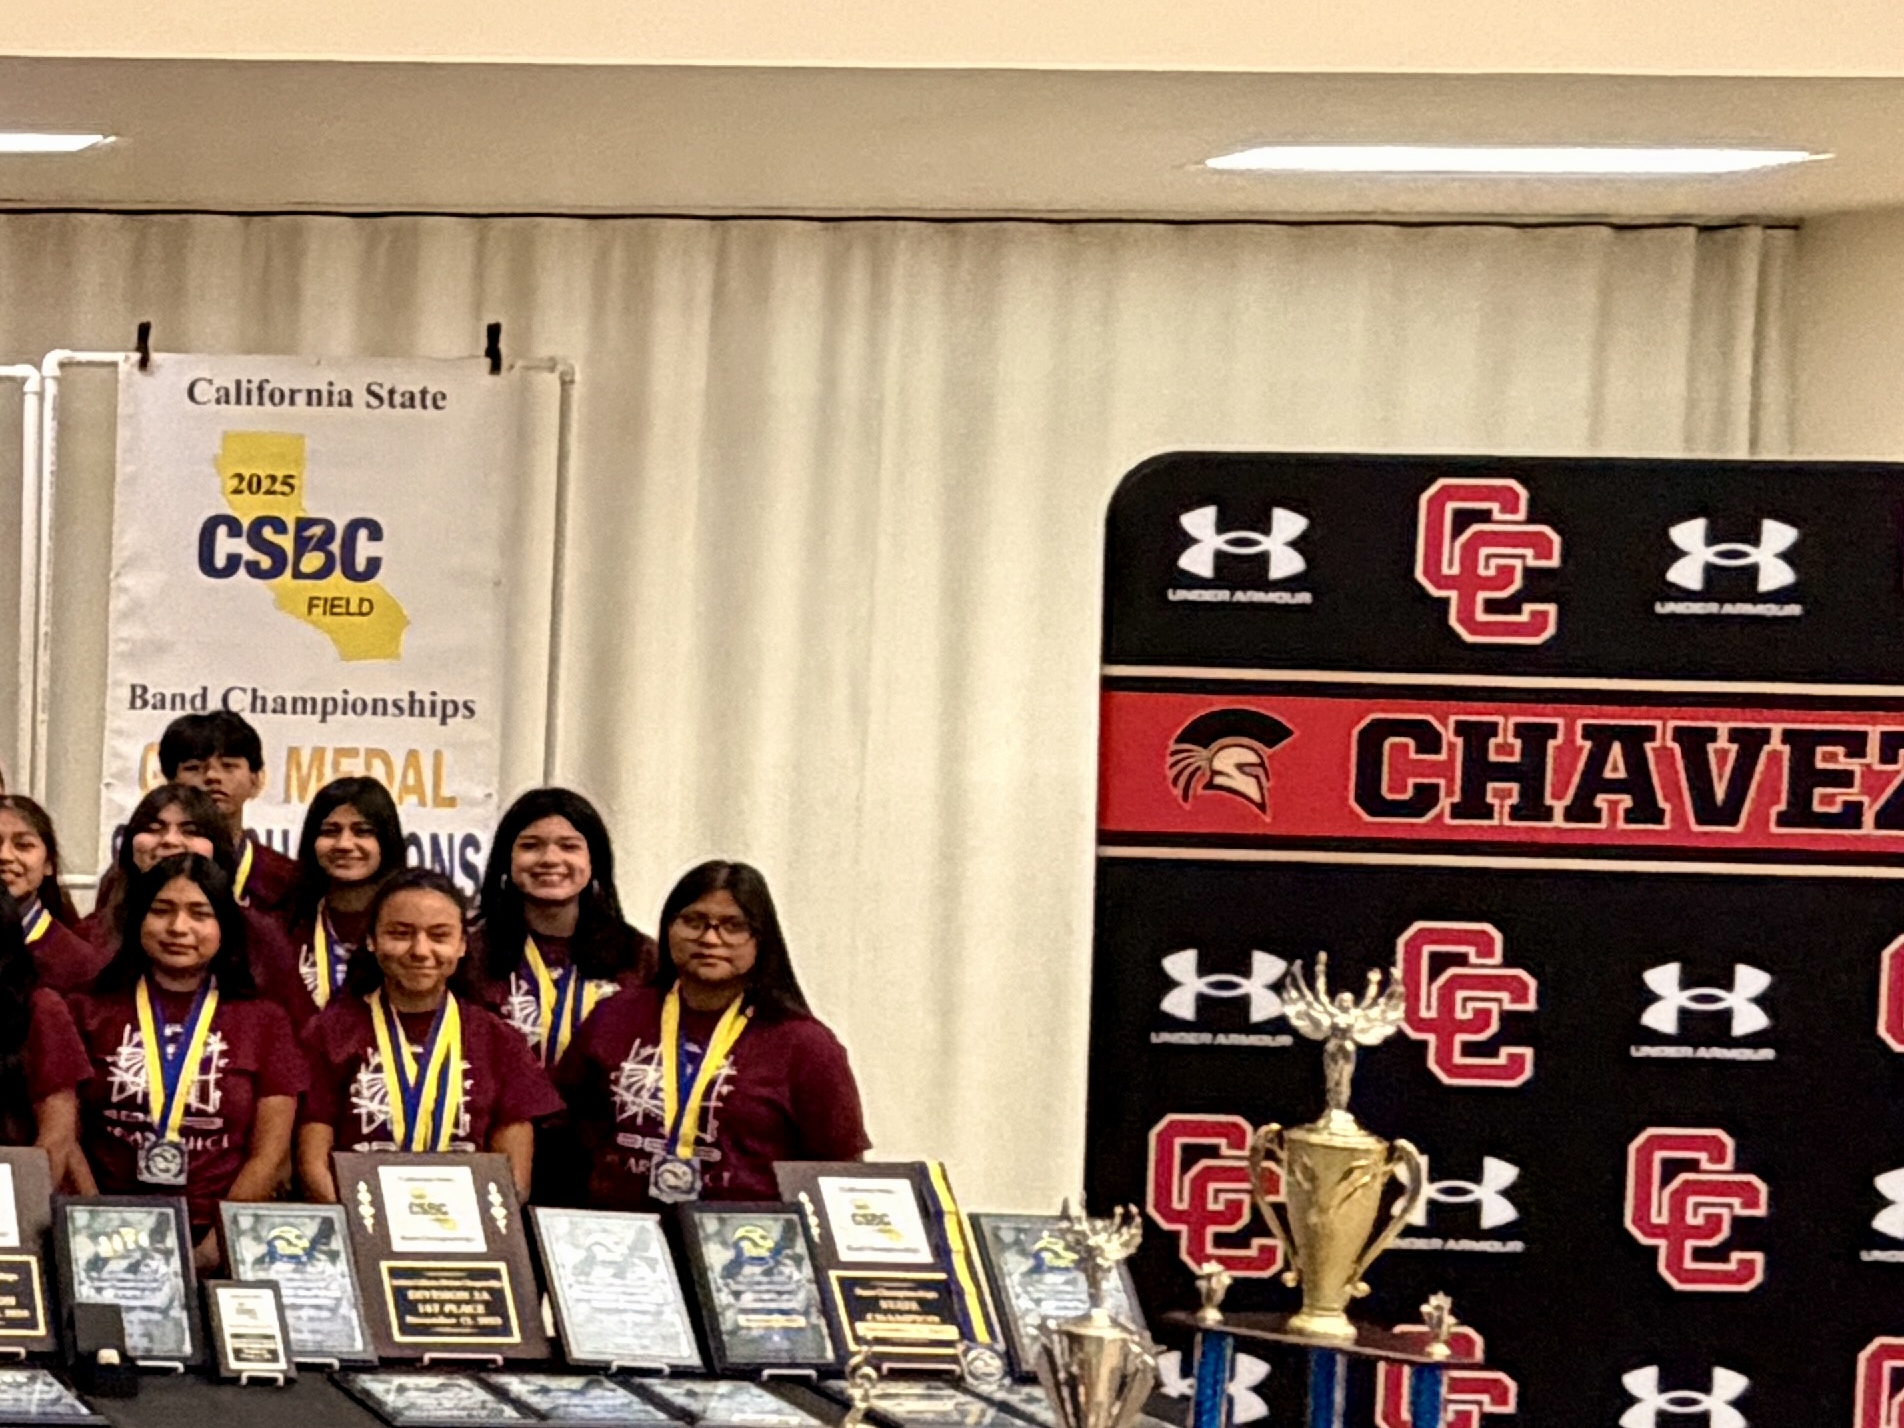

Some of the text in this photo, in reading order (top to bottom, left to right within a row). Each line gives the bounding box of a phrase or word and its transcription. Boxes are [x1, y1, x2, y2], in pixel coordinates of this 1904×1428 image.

[186, 376, 447, 411] California State
[229, 472, 296, 496] 2025
[198, 513, 384, 582] CSBC
[1415, 478, 1562, 645] CC
[307, 596, 374, 617] FIELD
[127, 682, 477, 726] Band Championships
[1397, 920, 1538, 1088] CC
[1623, 1126, 1769, 1293] CC
